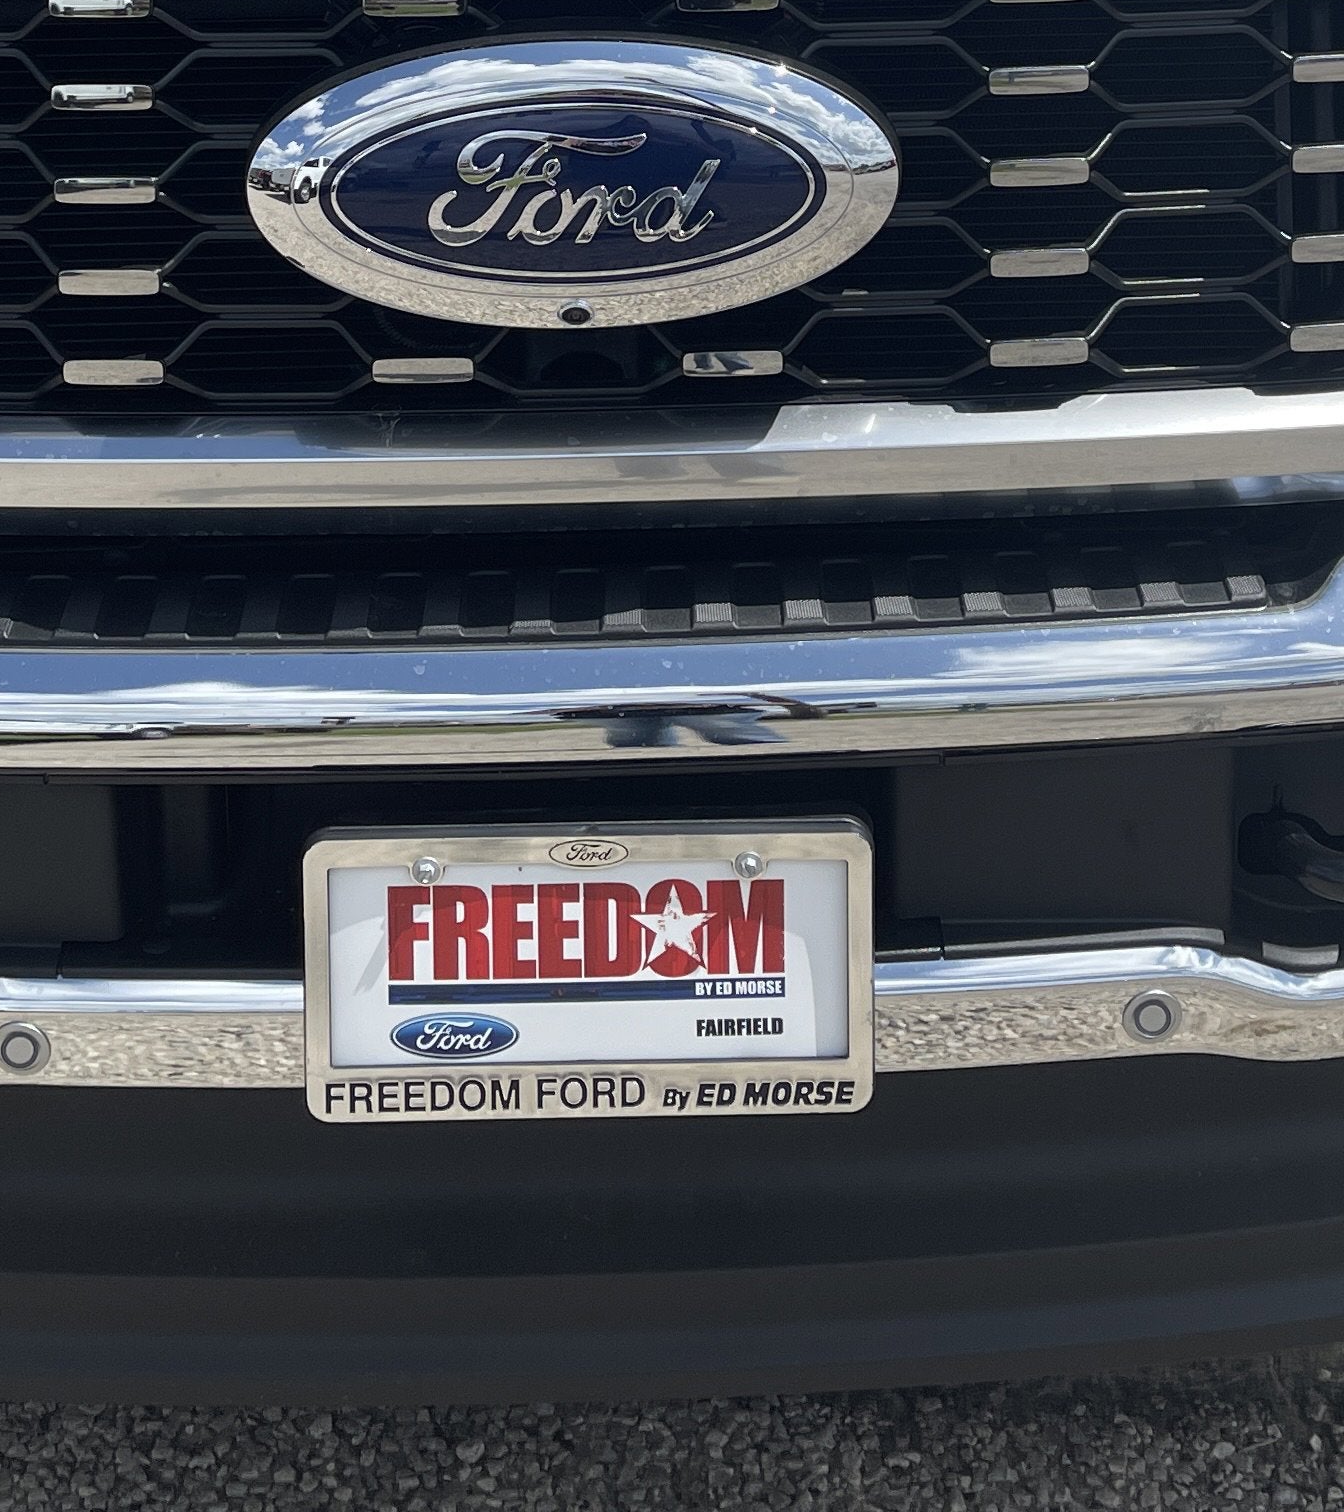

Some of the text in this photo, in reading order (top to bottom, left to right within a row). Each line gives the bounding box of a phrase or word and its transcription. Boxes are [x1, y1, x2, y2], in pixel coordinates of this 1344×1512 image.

[427, 129, 722, 247] Ford
[566, 843, 613, 862] Ford
[387, 878, 785, 981] FREEDOM
[695, 980, 783, 996] BY ED MORSE
[415, 1019, 493, 1051] Ford
[696, 1017, 784, 1037] FAIRFIELD
[325, 1076, 855, 1114] FREEDOM FORD By ED MORSE
